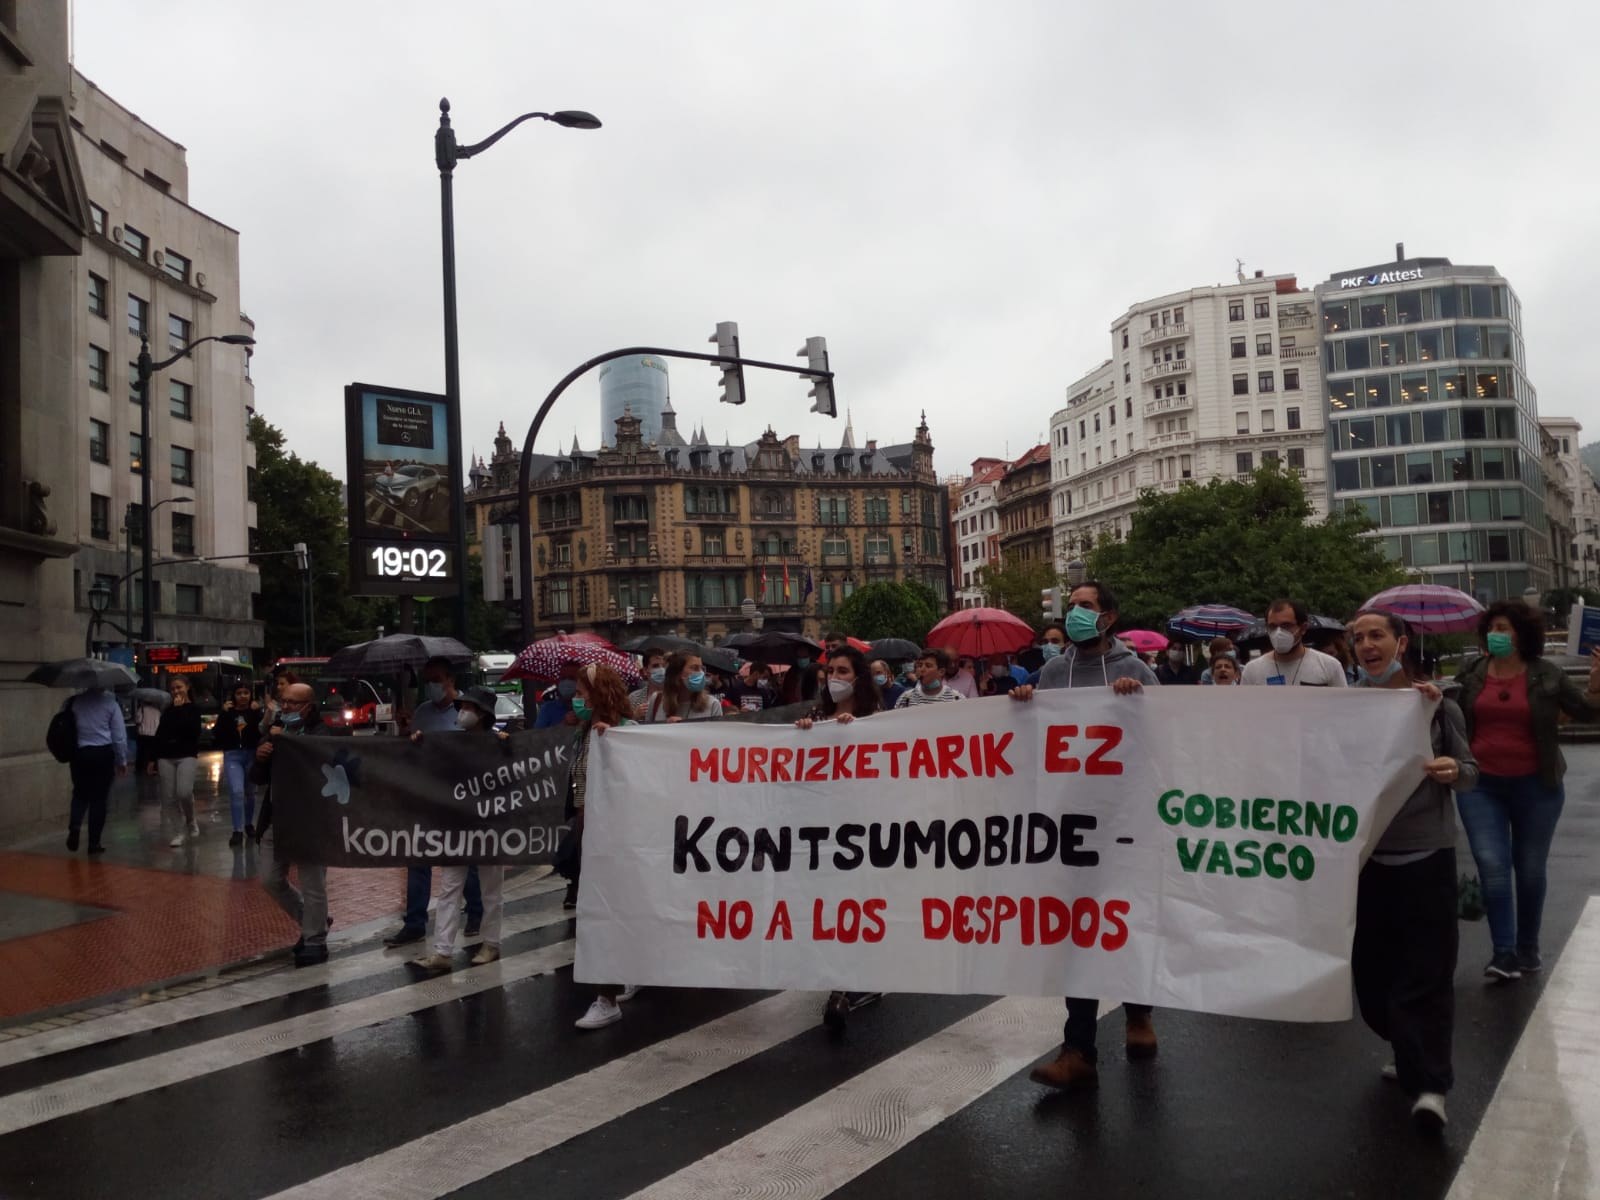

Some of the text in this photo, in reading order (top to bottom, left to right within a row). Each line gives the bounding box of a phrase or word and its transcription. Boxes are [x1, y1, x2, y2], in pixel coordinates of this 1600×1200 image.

[1341, 267, 1423, 288] PKF Attest
[372, 547, 447, 577] 19:02
[453, 744, 568, 802] GUGANDIK
[690, 725, 1123, 784] MURRIZKETARIK EZ
[477, 777, 557, 819] URRUN
[1157, 788, 1358, 842] GOBIERNO
[673, 812, 1100, 874] KONTSUMOBIDE
[1177, 838, 1315, 880] VASCO
[697, 895, 1131, 952] NO A LOS DESPIDOS
